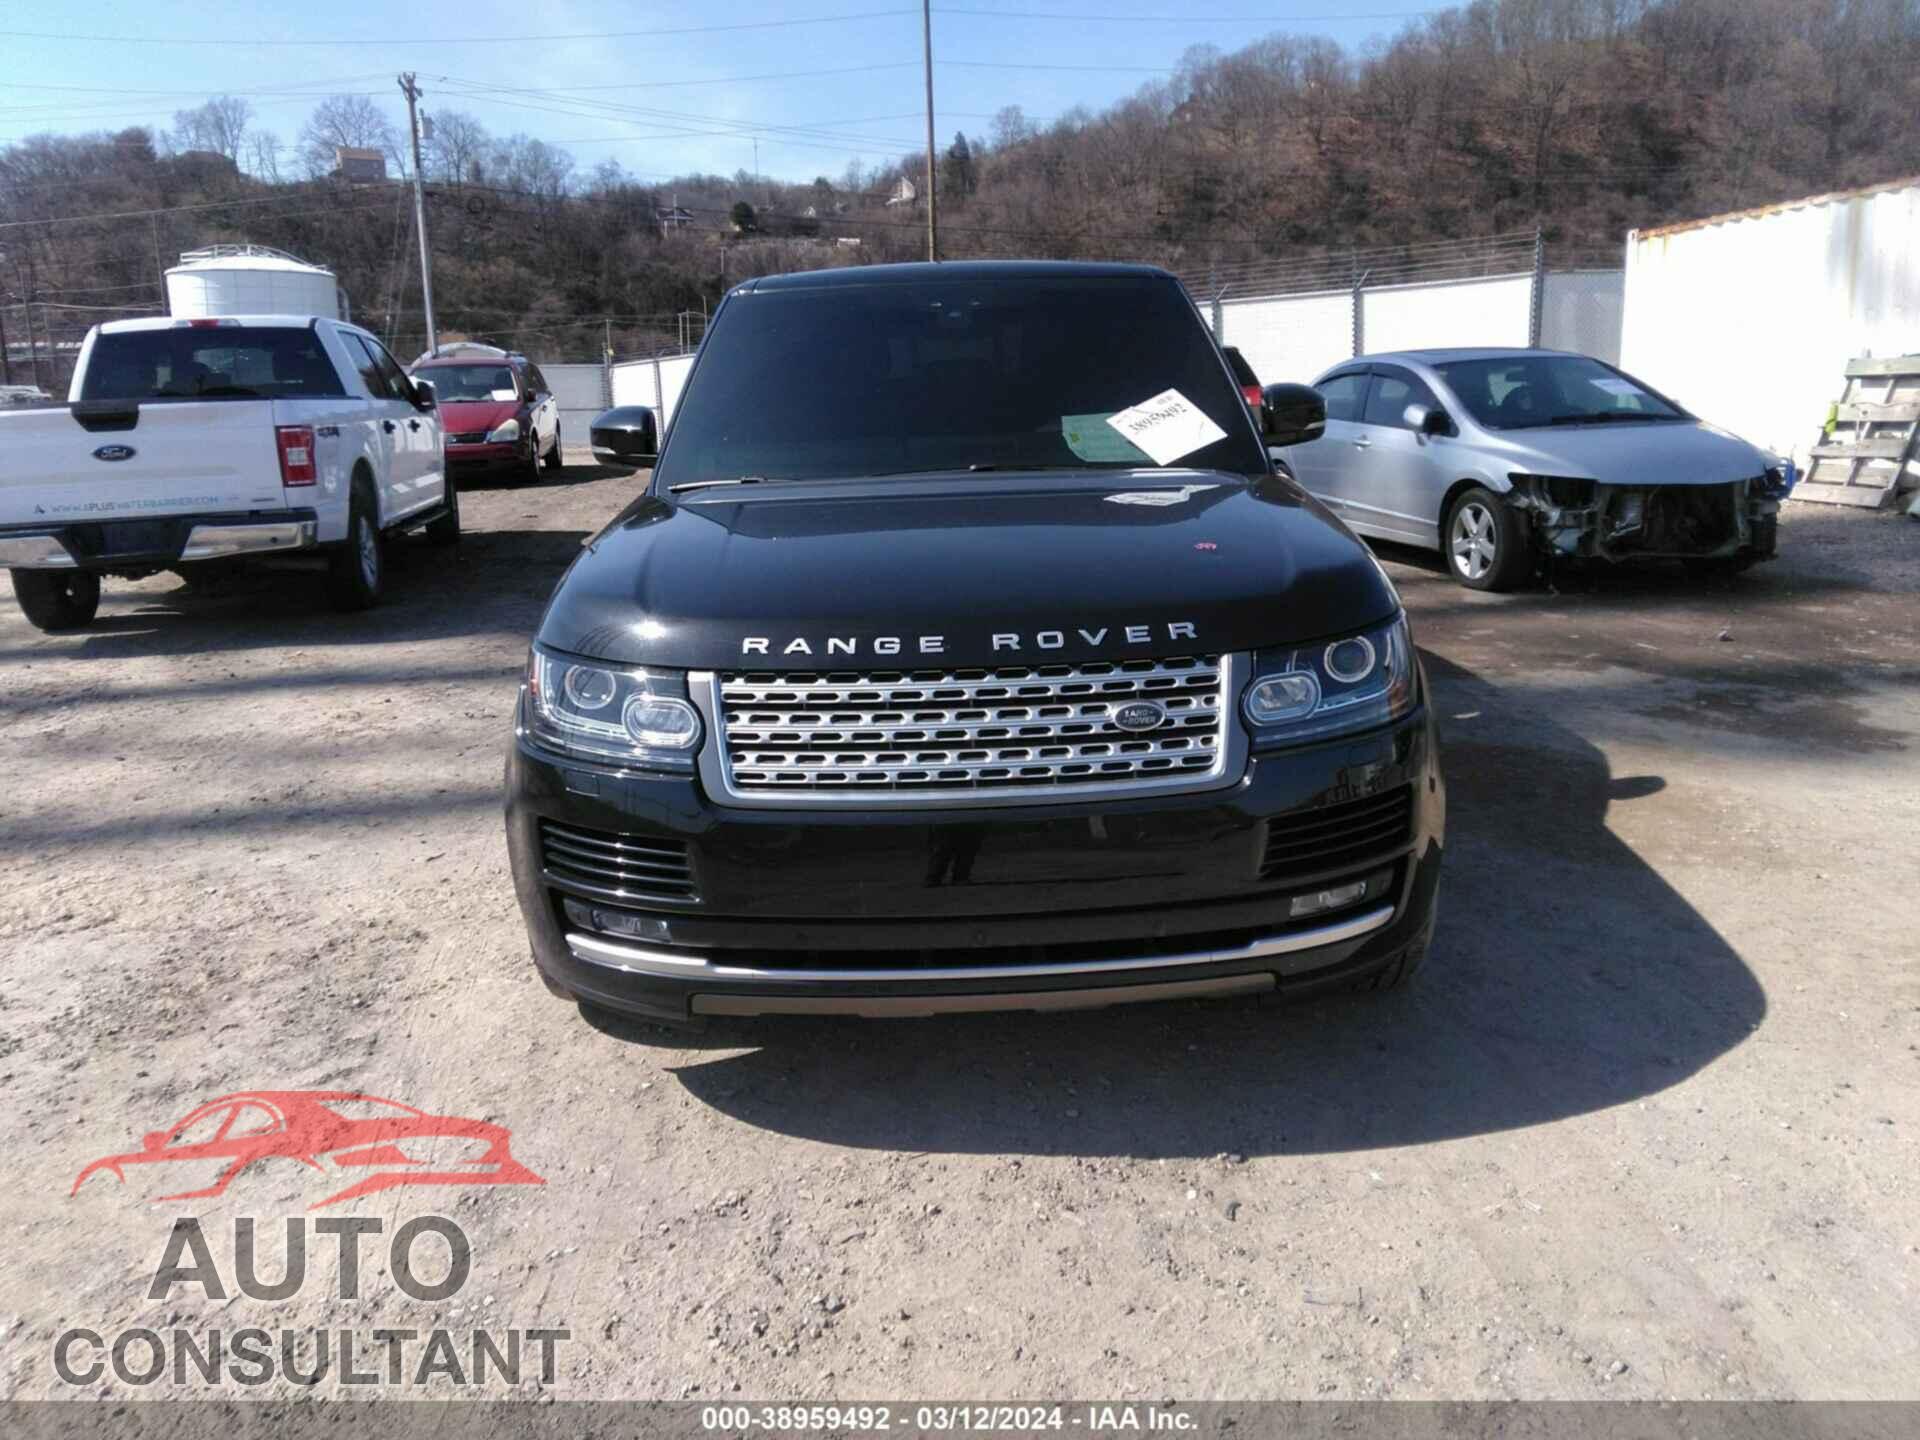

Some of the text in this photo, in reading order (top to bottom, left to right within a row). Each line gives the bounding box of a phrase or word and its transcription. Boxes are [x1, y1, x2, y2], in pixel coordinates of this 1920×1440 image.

[100, 448, 129, 458] Ford
[743, 621, 1199, 655] RANGE ROVER
